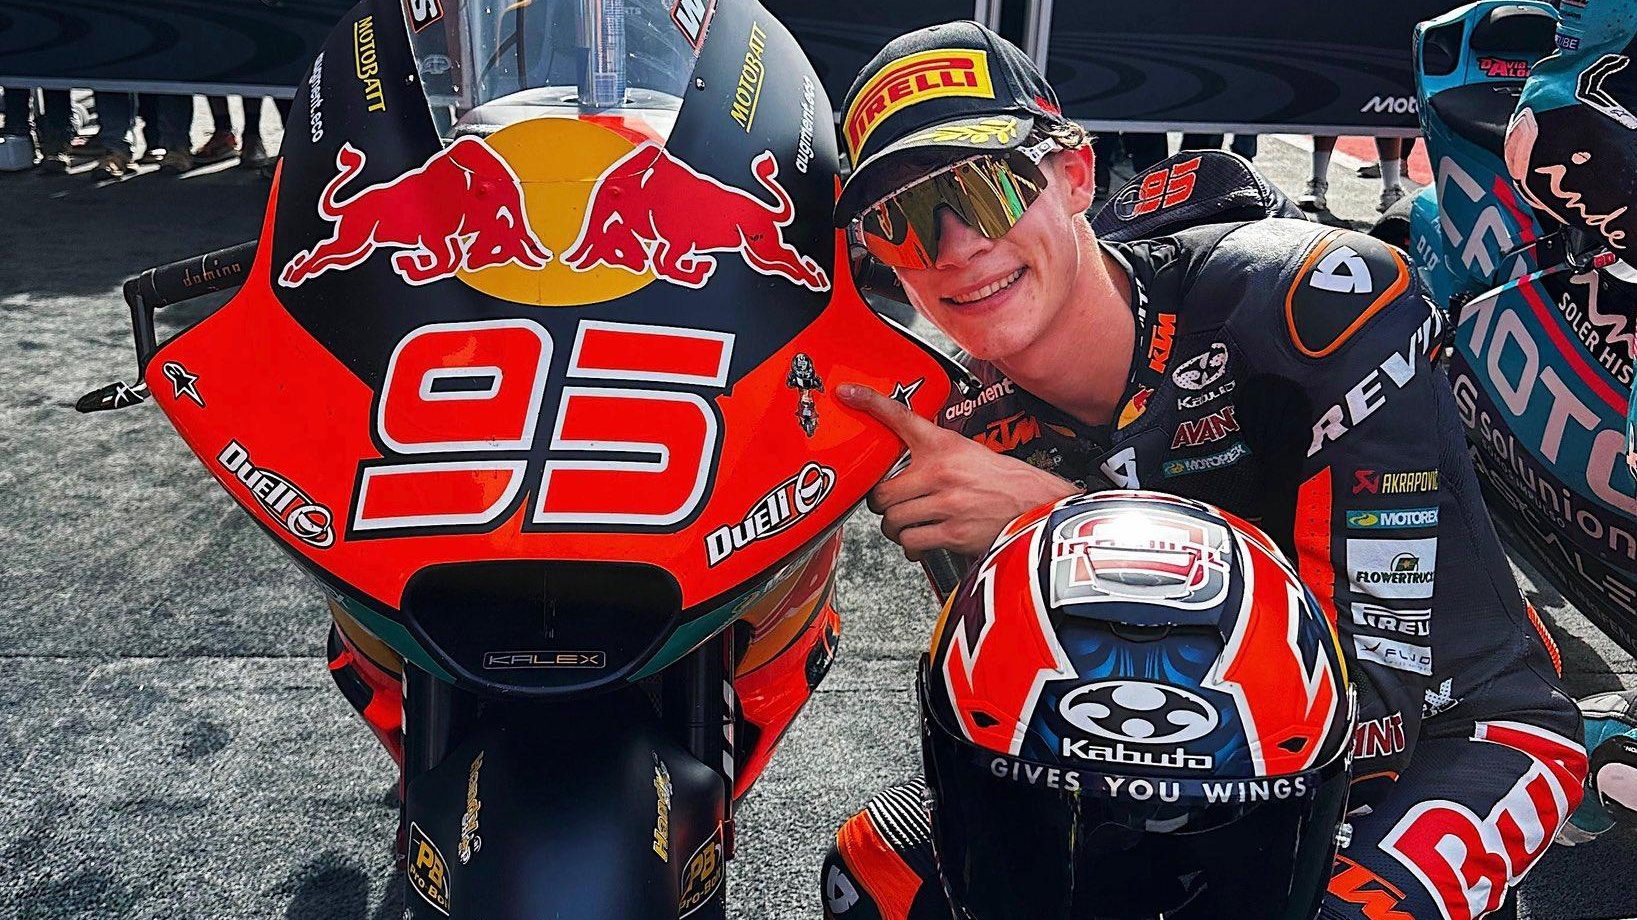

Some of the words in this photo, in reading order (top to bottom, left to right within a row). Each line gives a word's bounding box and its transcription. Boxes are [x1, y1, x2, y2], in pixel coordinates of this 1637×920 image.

[356, 15, 387, 112] MOTOBATT
[730, 21, 767, 128] MOTOBATT
[796, 75, 816, 174] augment.eco
[849, 57, 978, 154] PIRELLI
[1360, 96, 1419, 114] Mot
[1132, 156, 1203, 217] 95
[1148, 313, 1177, 374] KTM
[1558, 292, 1601, 353] SOLER
[1600, 346, 1635, 387] HIS
[352, 318, 736, 531] 95
[1186, 445, 1246, 471] MOTOREX
[488, 654, 599, 665] KALEX
[990, 757, 1081, 792] GIVES
[1103, 776, 1180, 803] YOU
[1202, 776, 1307, 804] WINGS
[1063, 737, 1213, 769] Kabuto
[416, 839, 444, 889] PB
[690, 841, 716, 881] PB
